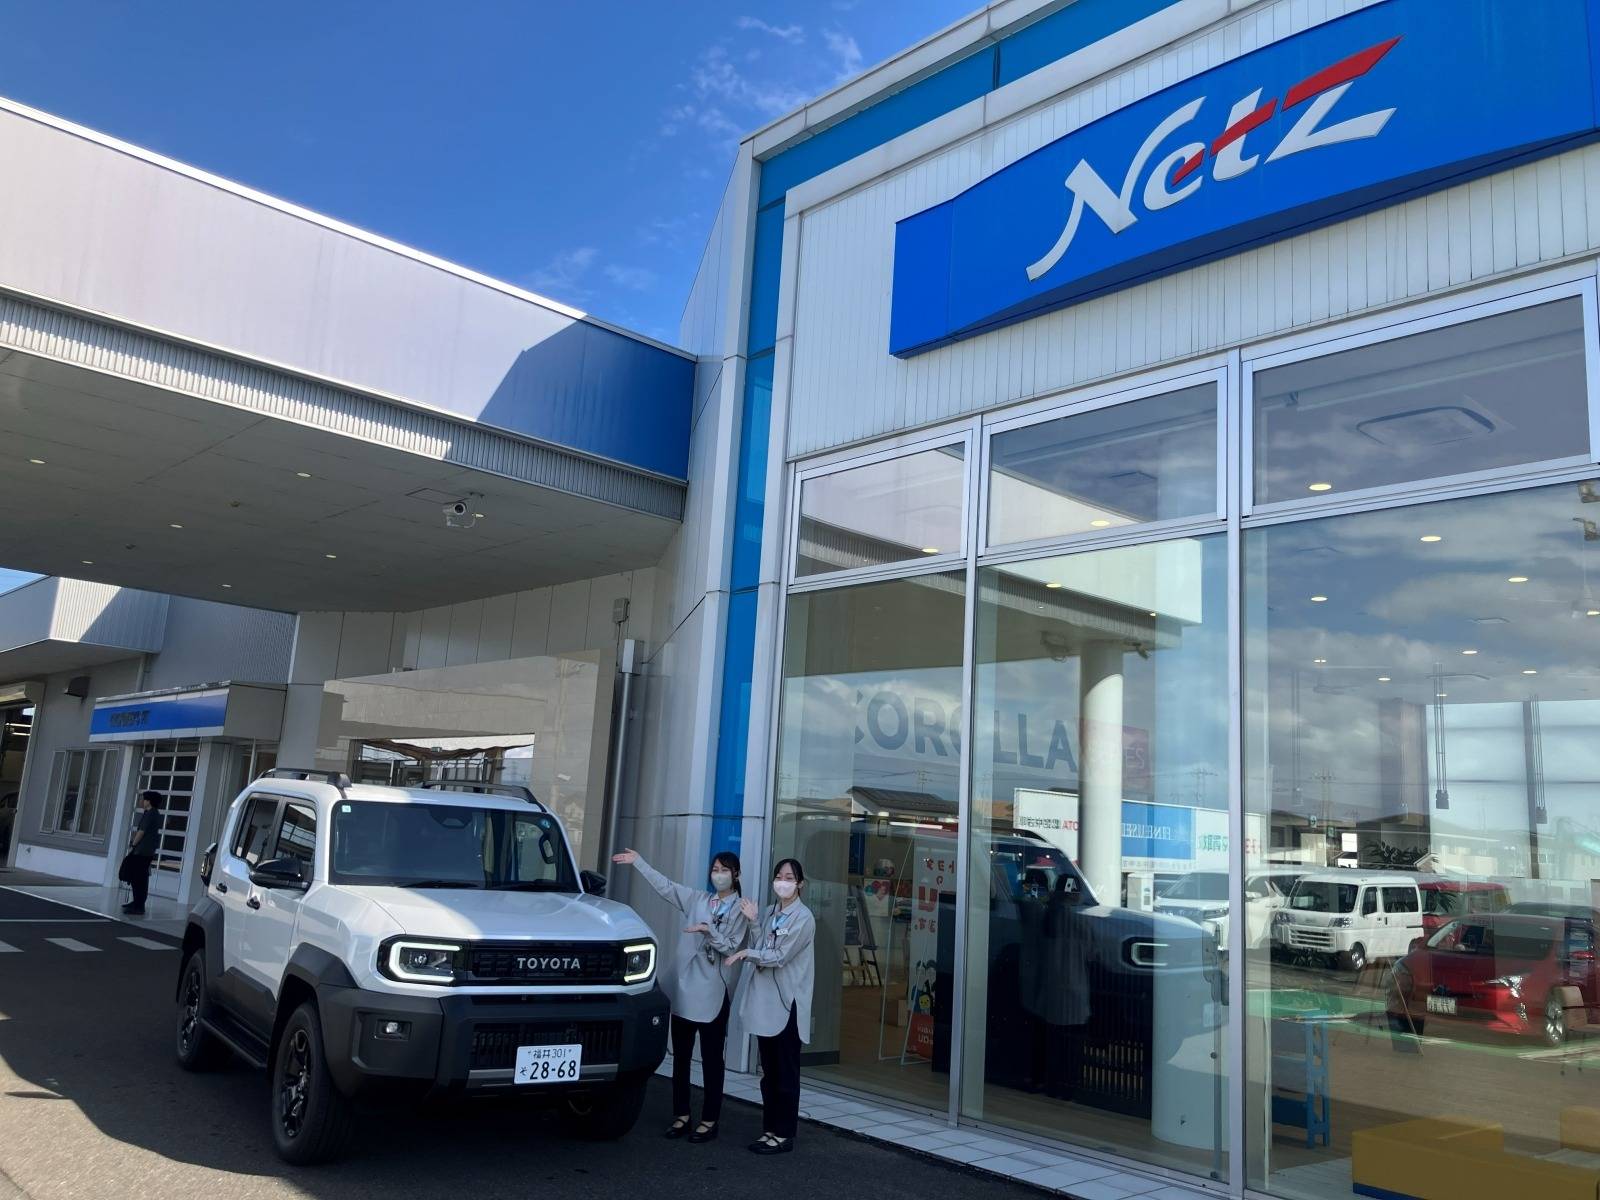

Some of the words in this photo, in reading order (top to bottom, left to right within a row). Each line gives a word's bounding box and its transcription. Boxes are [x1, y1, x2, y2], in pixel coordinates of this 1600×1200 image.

[1026, 34, 1403, 282] Netz
[855, 689, 1077, 773] ORLLA
[517, 957, 581, 969] TOYOTA
[530, 1059, 577, 1080] 28-68
